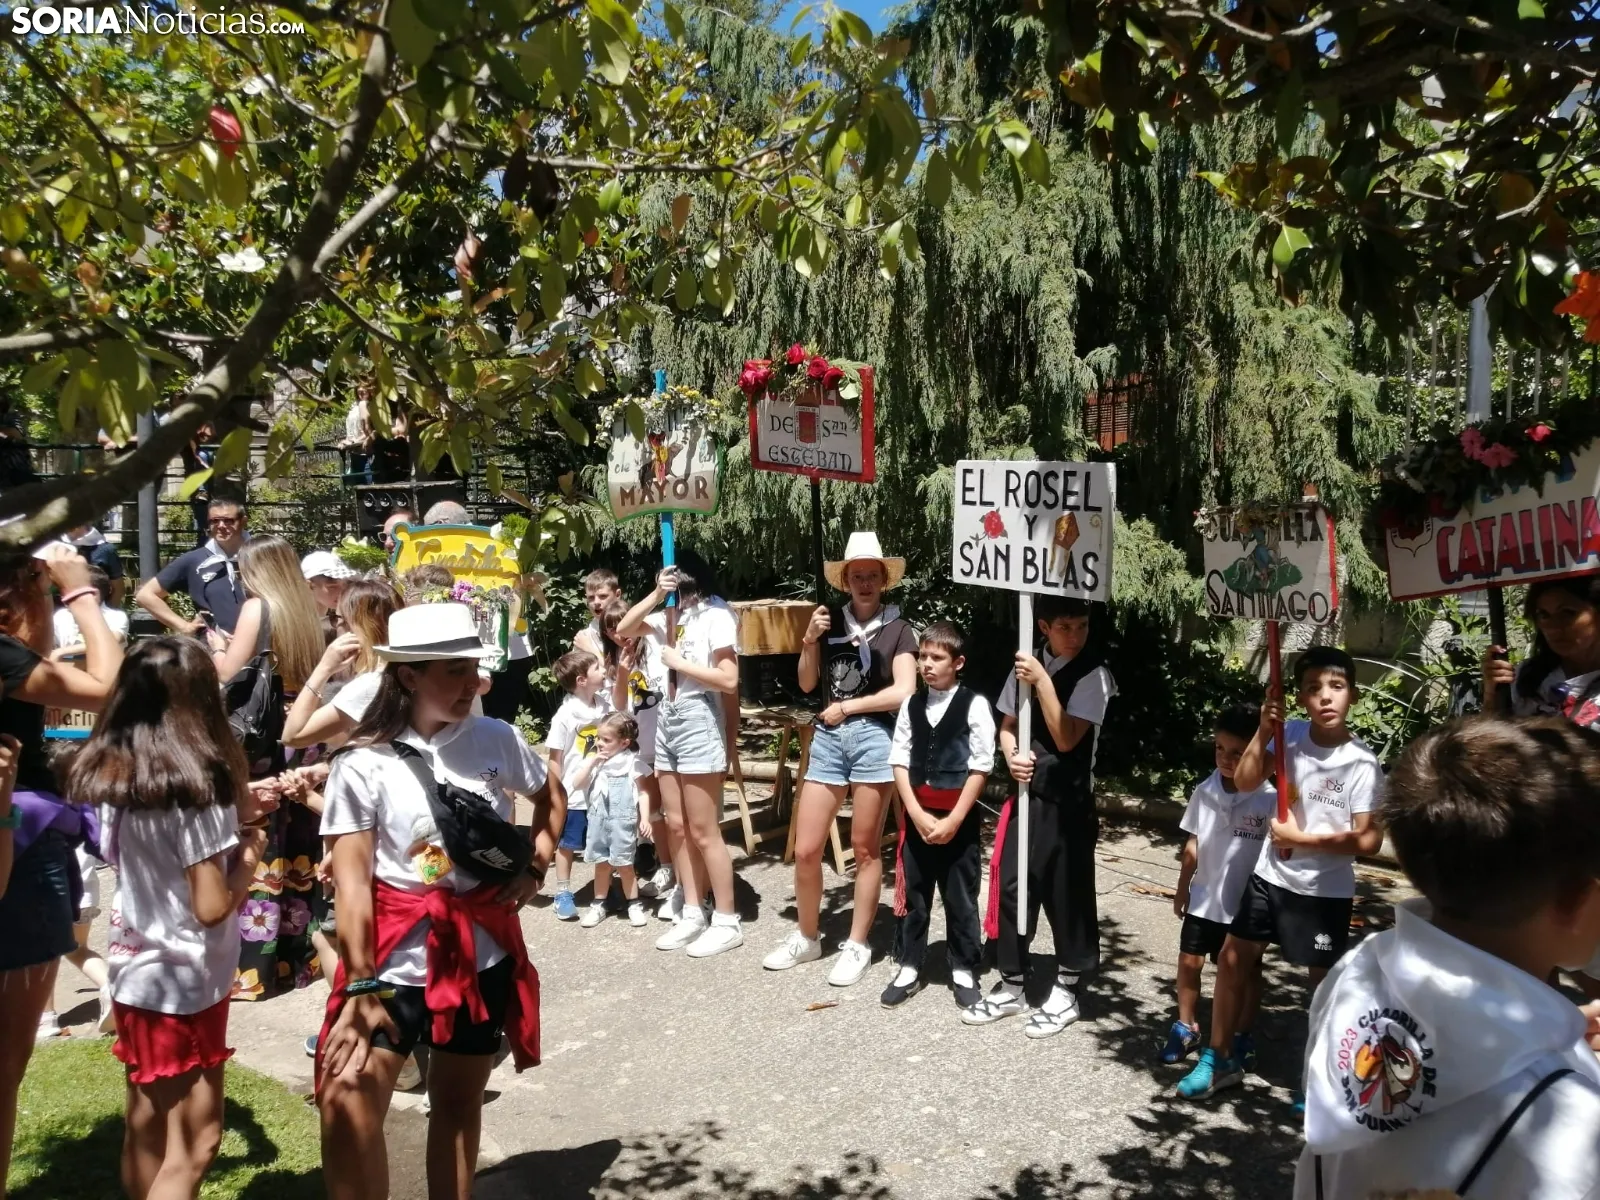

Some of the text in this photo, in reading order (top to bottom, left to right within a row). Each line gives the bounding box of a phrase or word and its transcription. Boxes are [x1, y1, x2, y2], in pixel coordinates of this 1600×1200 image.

[769, 414, 794, 434] DE
[768, 445, 852, 472] ESTEBAN
[619, 475, 710, 507] MAYOR
[961, 468, 1103, 513] EL ROSEL
[1023, 513, 1039, 541] Y
[959, 540, 1100, 593] SAN BLAS
[1206, 569, 1329, 623] SANTIAGO
[1308, 792, 1346, 809] SANTIAGO
[482, 846, 514, 867] NIKE
[1338, 1028, 1358, 1071] 2023
[1358, 1007, 1437, 1098] CUADRILLA DE
